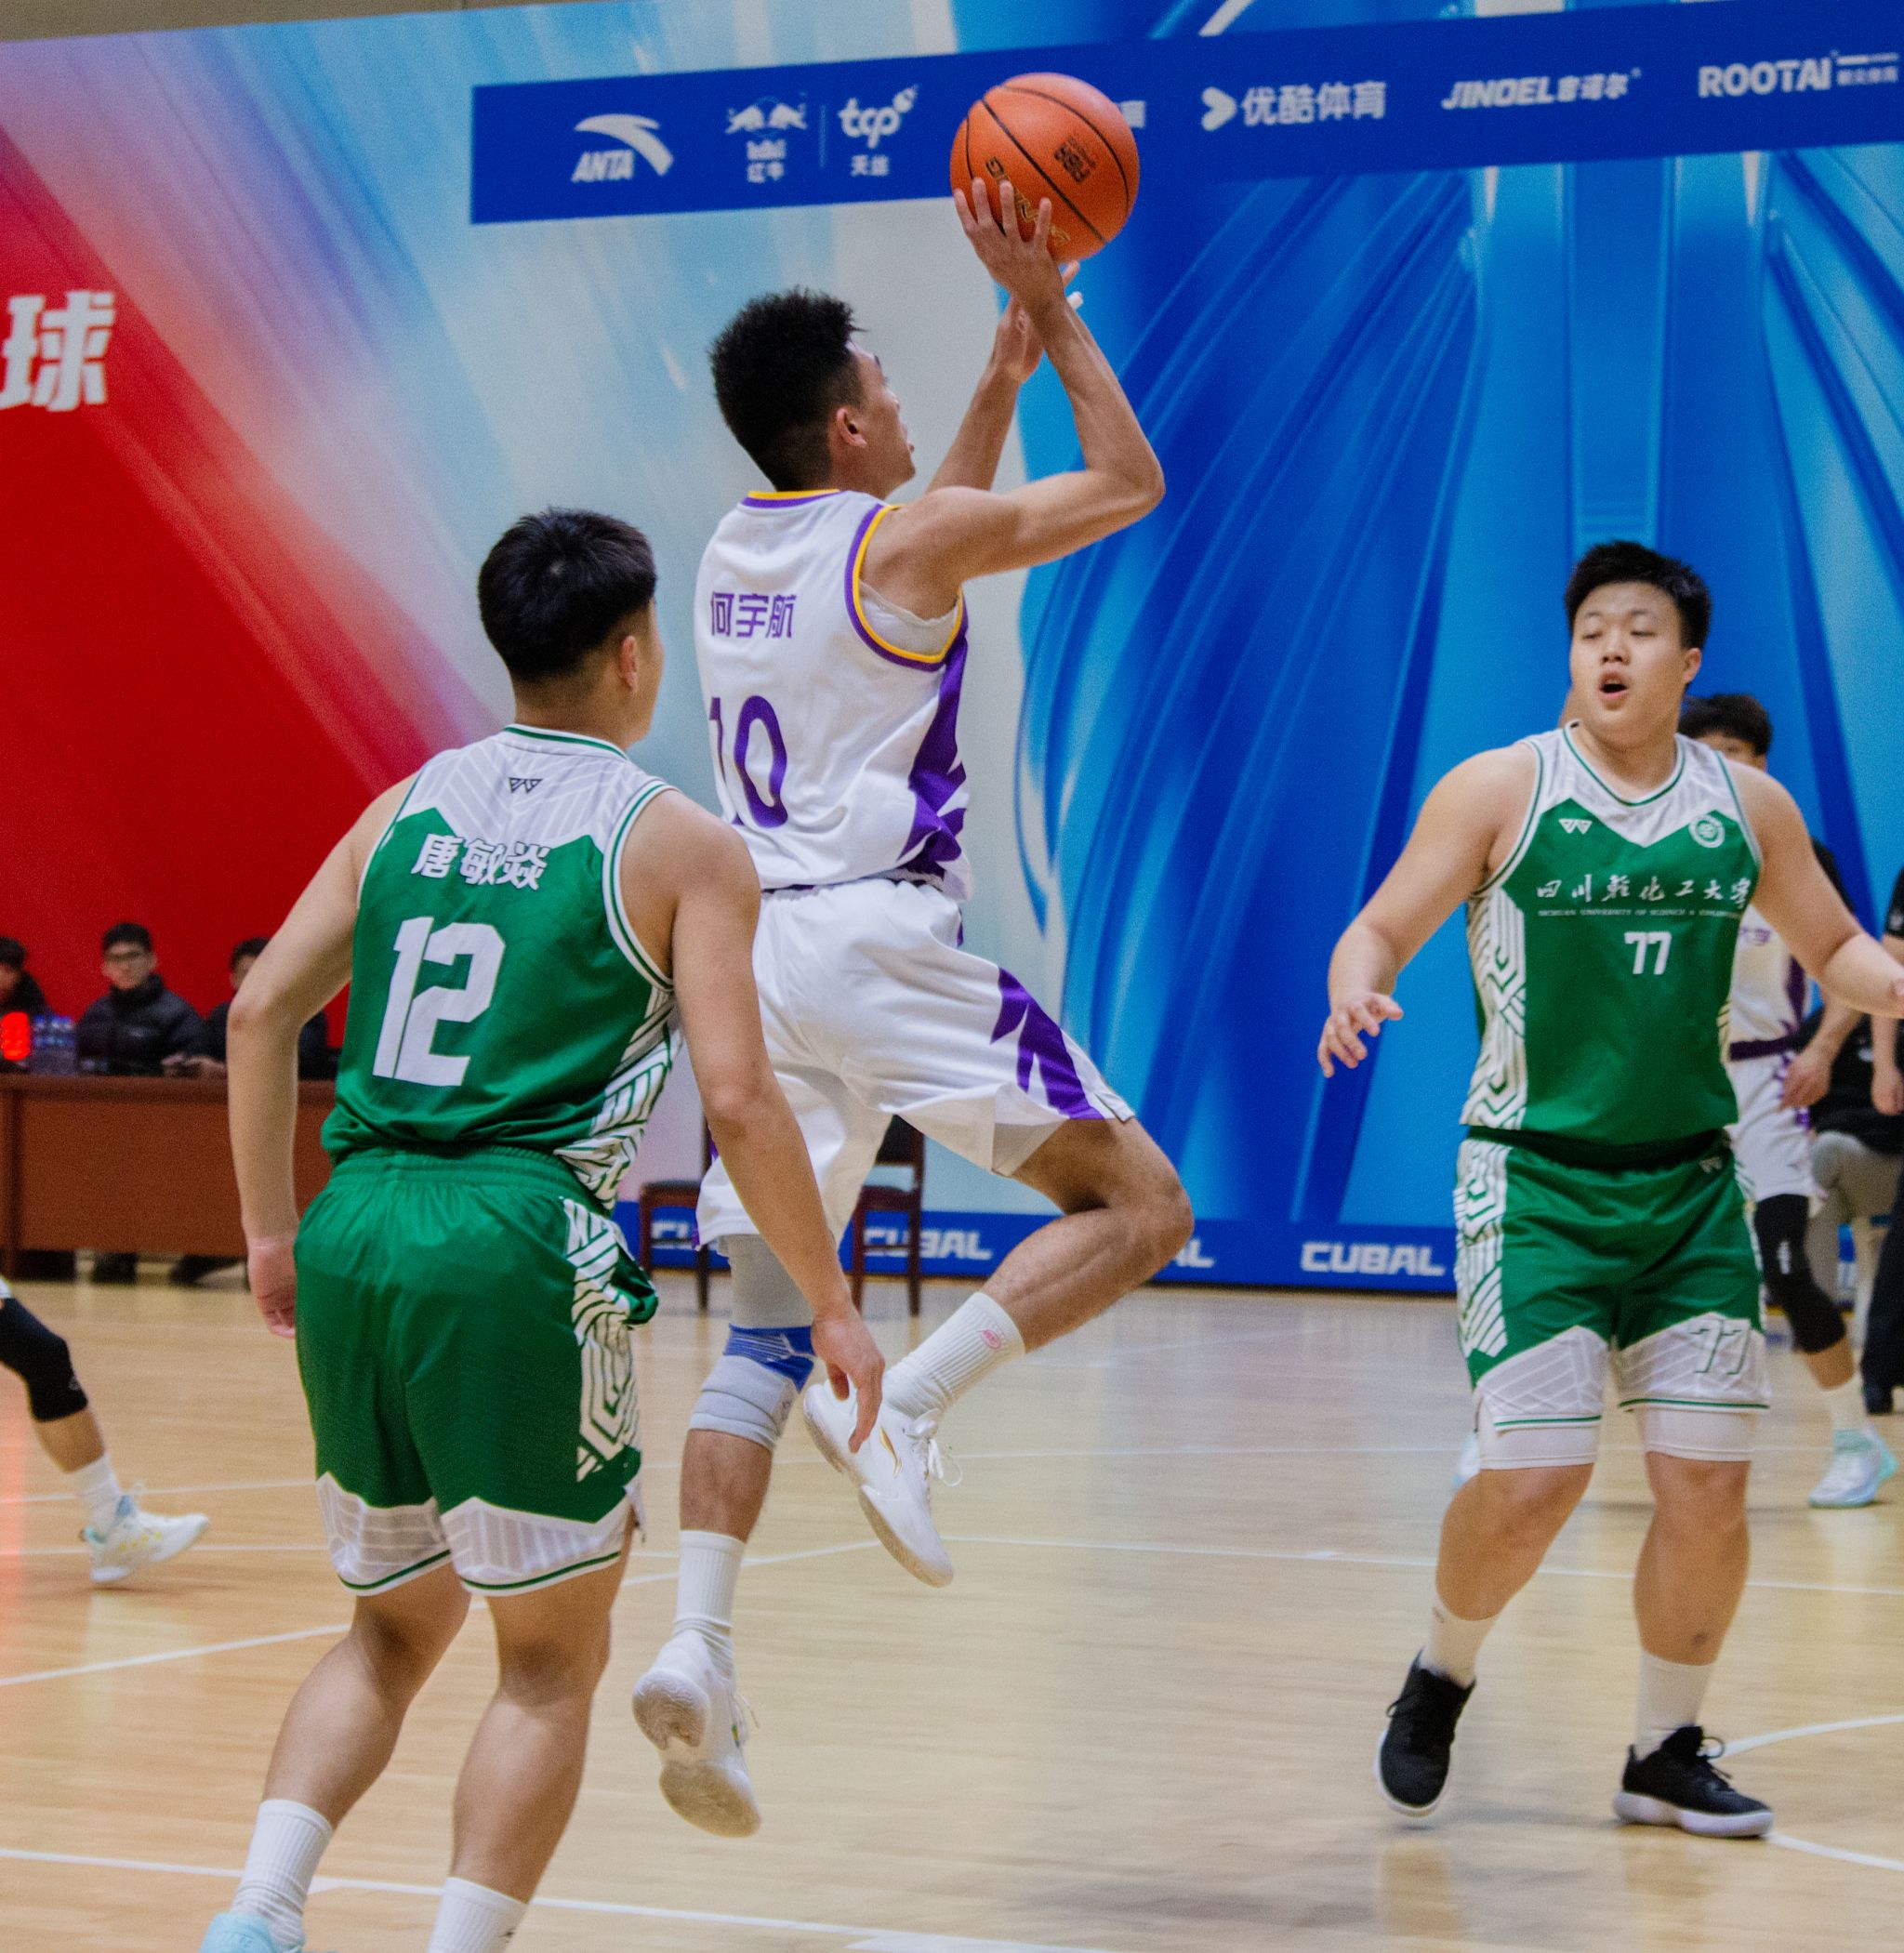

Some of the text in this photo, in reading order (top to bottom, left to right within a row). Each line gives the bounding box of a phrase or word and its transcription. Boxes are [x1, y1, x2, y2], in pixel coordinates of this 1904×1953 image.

[1698, 57, 1831, 98] ROOTAI
[1241, 80, 1386, 126] 优酷体育
[571, 149, 634, 183] ANTA
[0, 290, 116, 412] 球
[710, 591, 797, 639] 何宇航
[708, 695, 788, 828] 10
[410, 833, 552, 892] 唐敏焱
[1624, 930, 1673, 975] 77
[372, 916, 506, 1087] 12
[1302, 1240, 1446, 1277] CUBAL
[1688, 1318, 1752, 1376] 77
